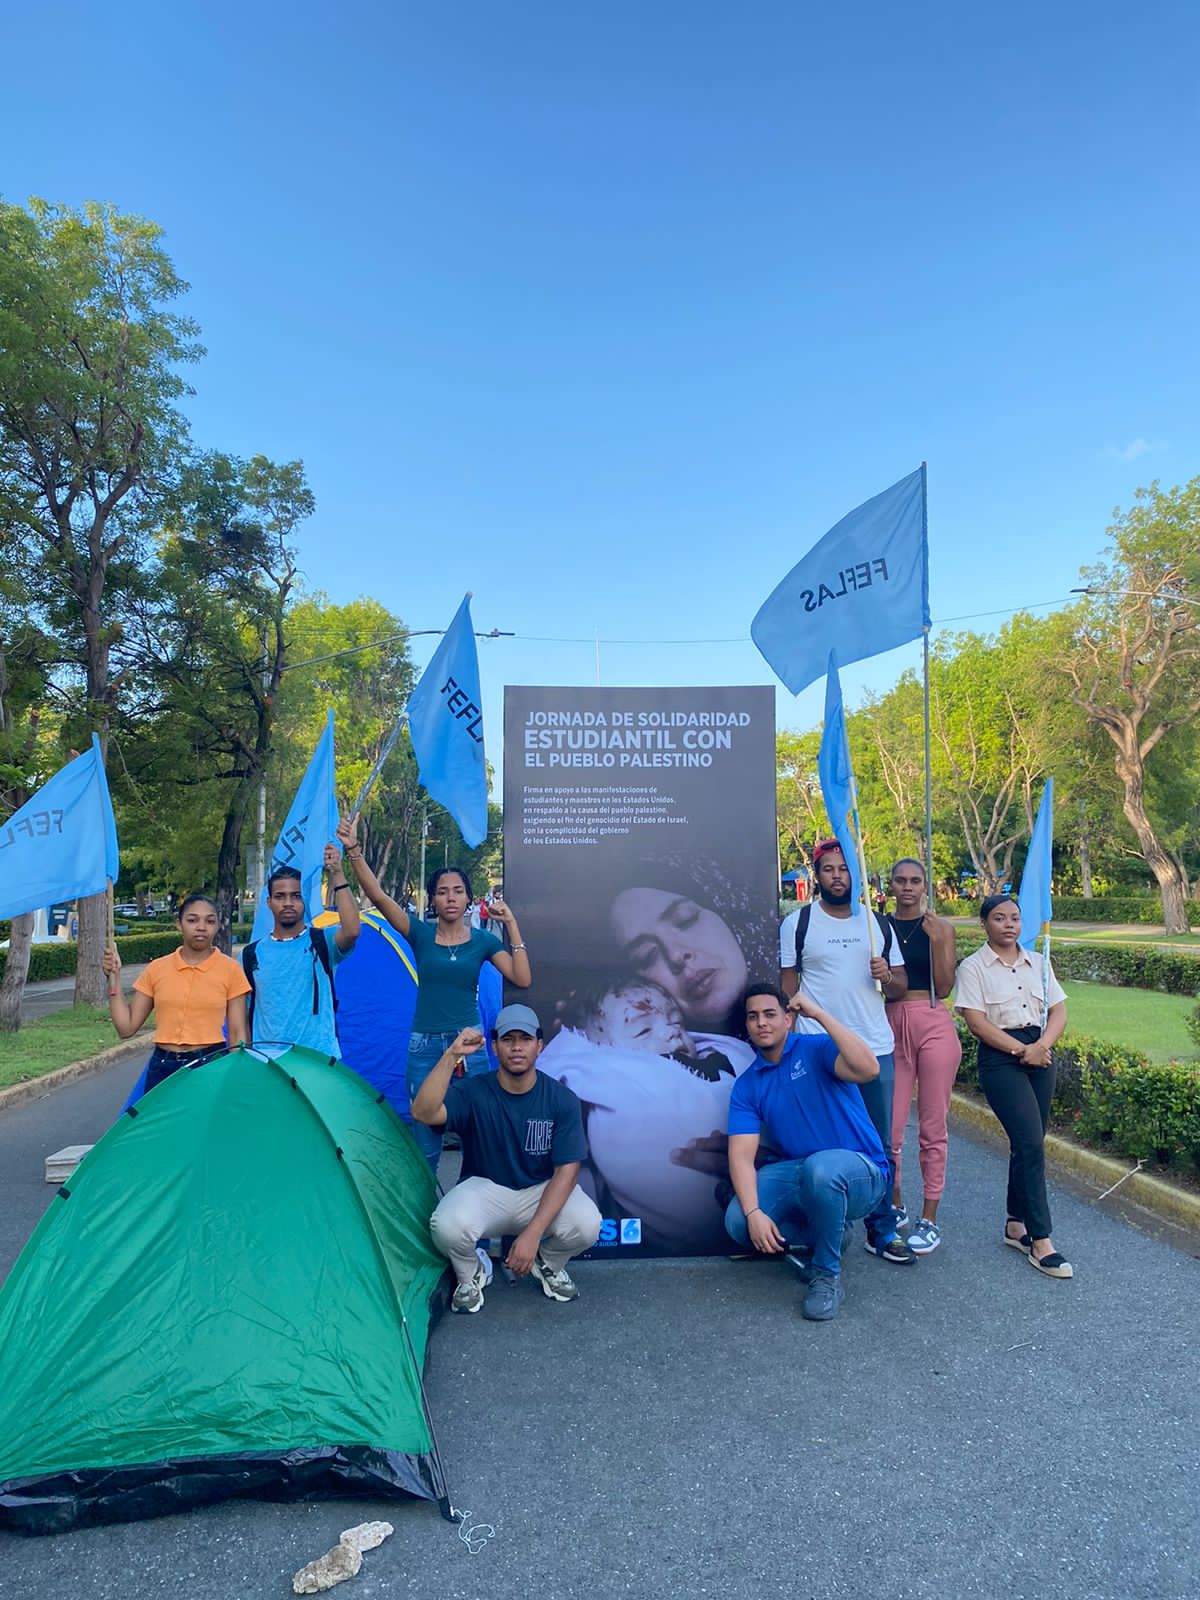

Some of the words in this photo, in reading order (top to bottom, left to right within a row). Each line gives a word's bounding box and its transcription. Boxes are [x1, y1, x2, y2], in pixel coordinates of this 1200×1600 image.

[526, 712, 607, 726] JORNADA
[611, 712, 634, 726] DE
[638, 712, 751, 726] SOLIDARIDAD
[525, 730, 677, 749] ESTUDIANTIL
[682, 730, 732, 749] CON
[525, 753, 545, 767] EL
[550, 753, 616, 767] PUEBLO
[620, 753, 713, 767] PALESTINO
[523, 786, 544, 794] Firma
[545, 786, 554, 794] en
[554, 786, 575, 795] apoyo
[581, 786, 592, 794] las
[593, 786, 648, 794] manifestaciones
[649, 786, 658, 794] de
[523, 796, 564, 804] estudiantes
[570, 796, 601, 804] maestros
[602, 796, 611, 804] en
[612, 796, 622, 804] los
[623, 796, 650, 804] Estados
[523, 806, 532, 814] en
[533, 806, 563, 816] respaldo
[570, 806, 577, 814] la
[578, 806, 599, 814] causa
[600, 806, 610, 814] del
[611, 806, 633, 816] pueblo
[523, 816, 556, 825] exigiendo
[557, 816, 564, 824] el
[565, 816, 574, 824] fin
[575, 816, 586, 824] del
[587, 816, 620, 825] genocidio
[621, 816, 632, 824] del
[633, 816, 657, 824] Estado
[657, 816, 667, 824] de
[667, 816, 689, 825] Israel,
[523, 826, 537, 834] con
[537, 826, 544, 834] la
[545, 826, 587, 835] complicidad
[588, 826, 599, 834] del
[600, 826, 630, 835] gobierno
[523, 836, 533, 844] de
[533, 836, 544, 844] los
[545, 836, 572, 844] Estados
